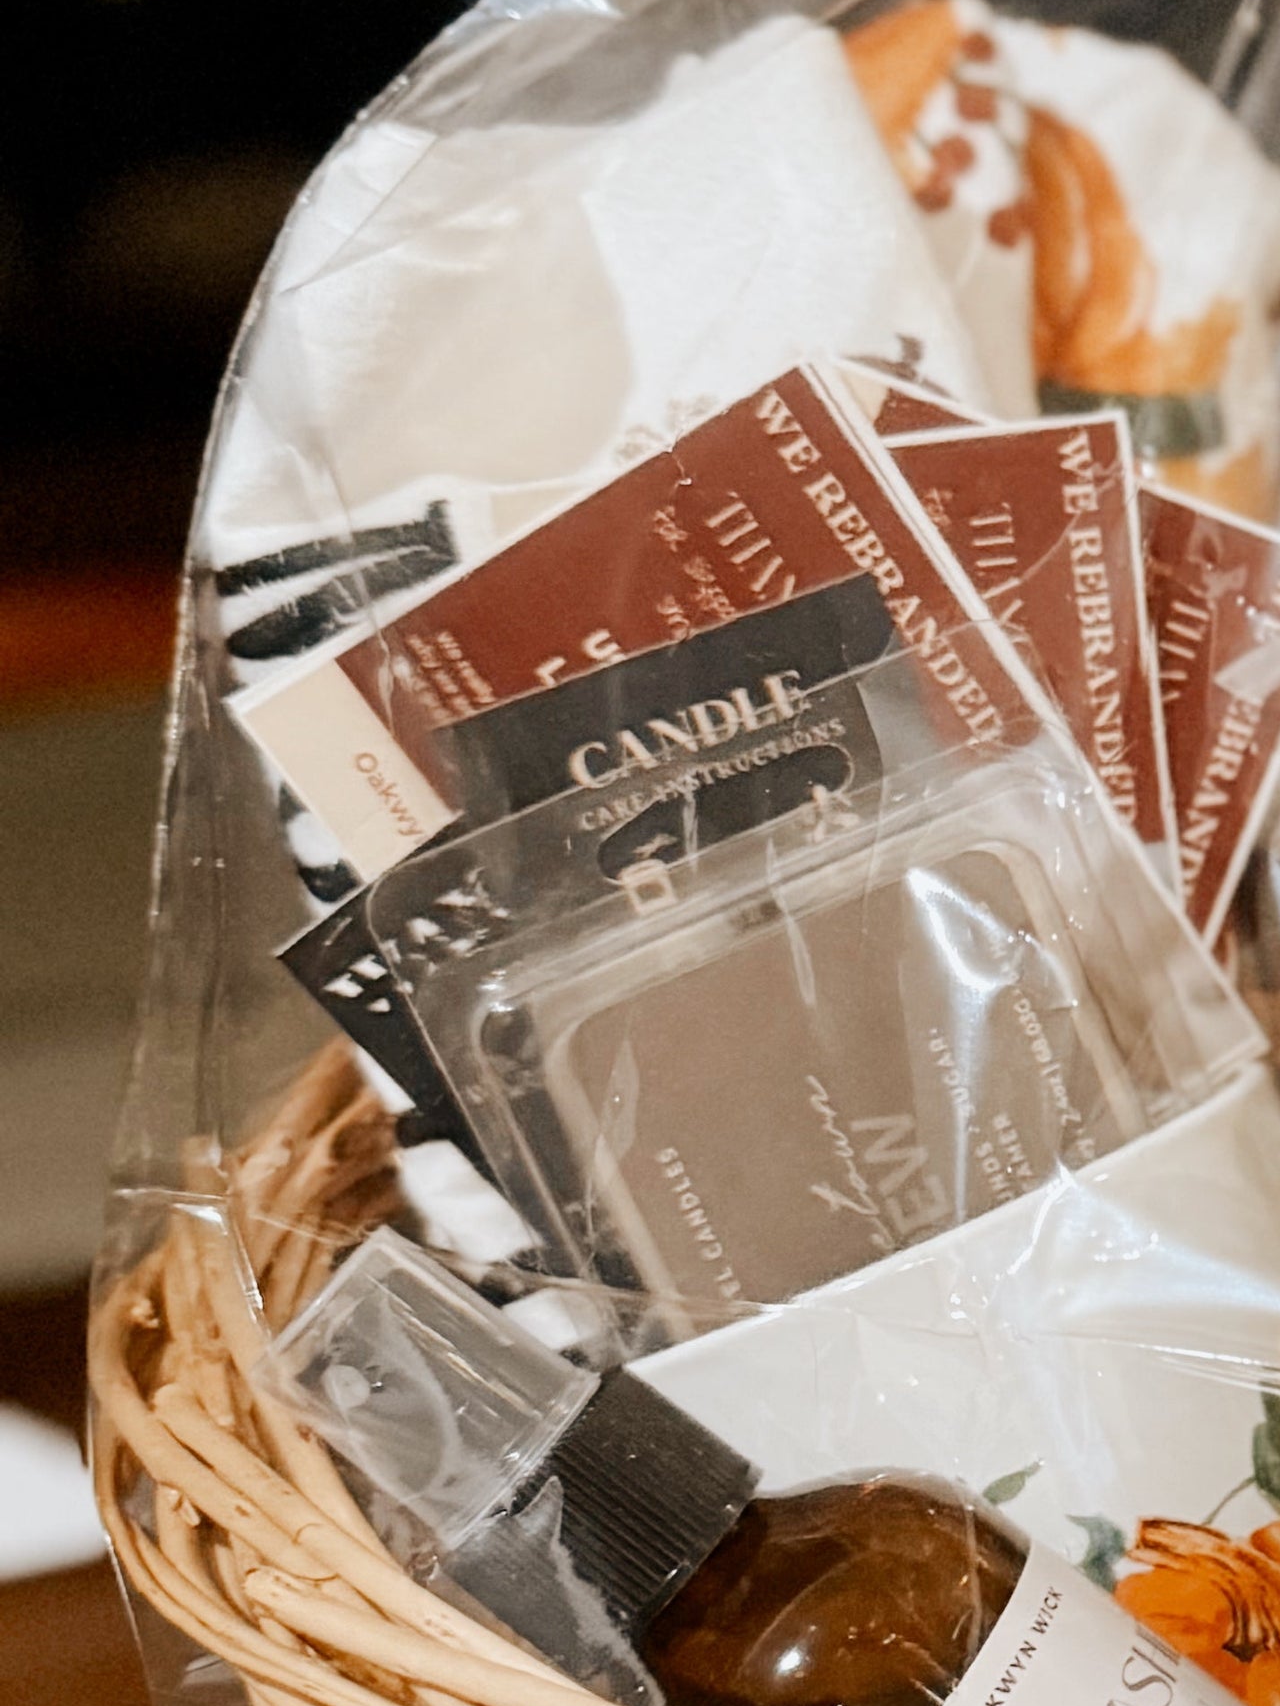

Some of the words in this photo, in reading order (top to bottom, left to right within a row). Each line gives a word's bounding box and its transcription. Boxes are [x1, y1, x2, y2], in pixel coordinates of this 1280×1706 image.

[1057, 429, 1099, 515] WE
[755, 387, 819, 473] WE
[803, 473, 1003, 745] REBRANDED
[567, 668, 806, 790] CANDLE
[657, 1147, 721, 1261] CANDLES
[1031, 1586, 1065, 1634] WICK
